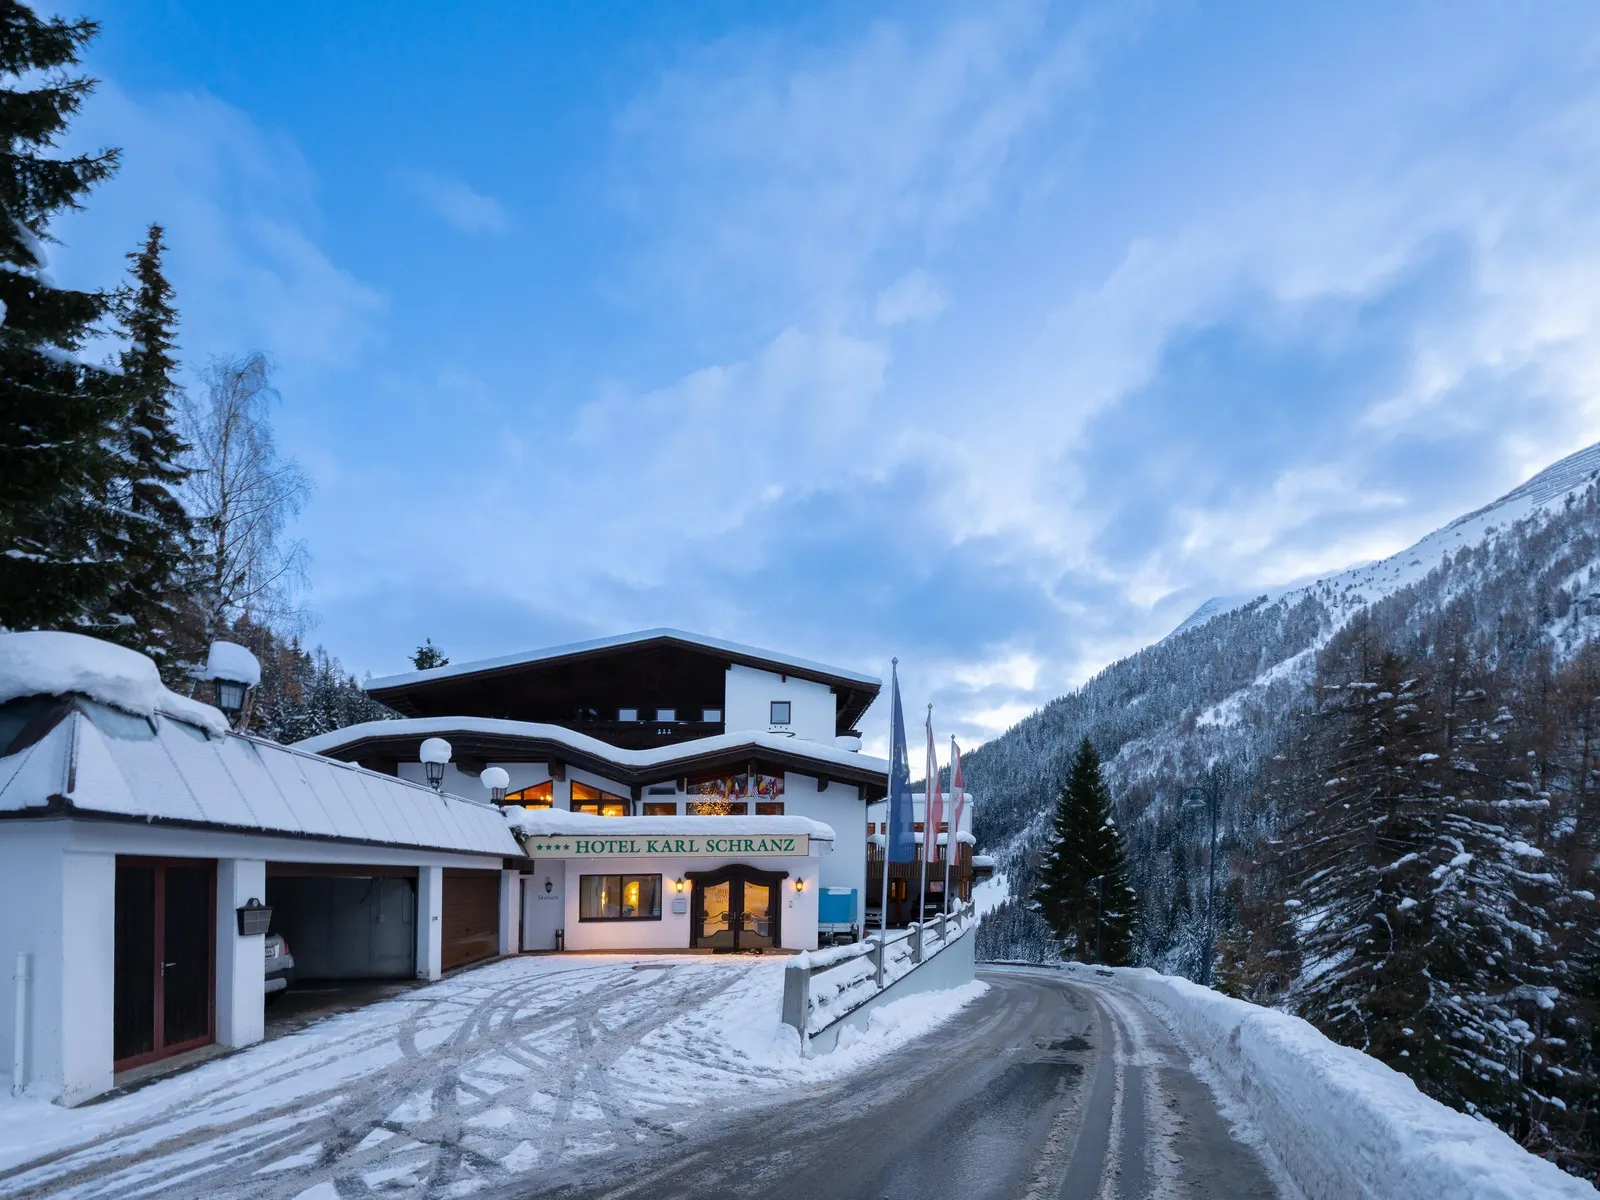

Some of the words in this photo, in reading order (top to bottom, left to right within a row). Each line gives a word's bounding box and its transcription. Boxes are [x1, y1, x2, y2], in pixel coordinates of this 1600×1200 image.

[575, 840, 641, 854] HOTEL
[646, 839, 700, 853] KARL
[706, 838, 796, 853] SCHRANZ
